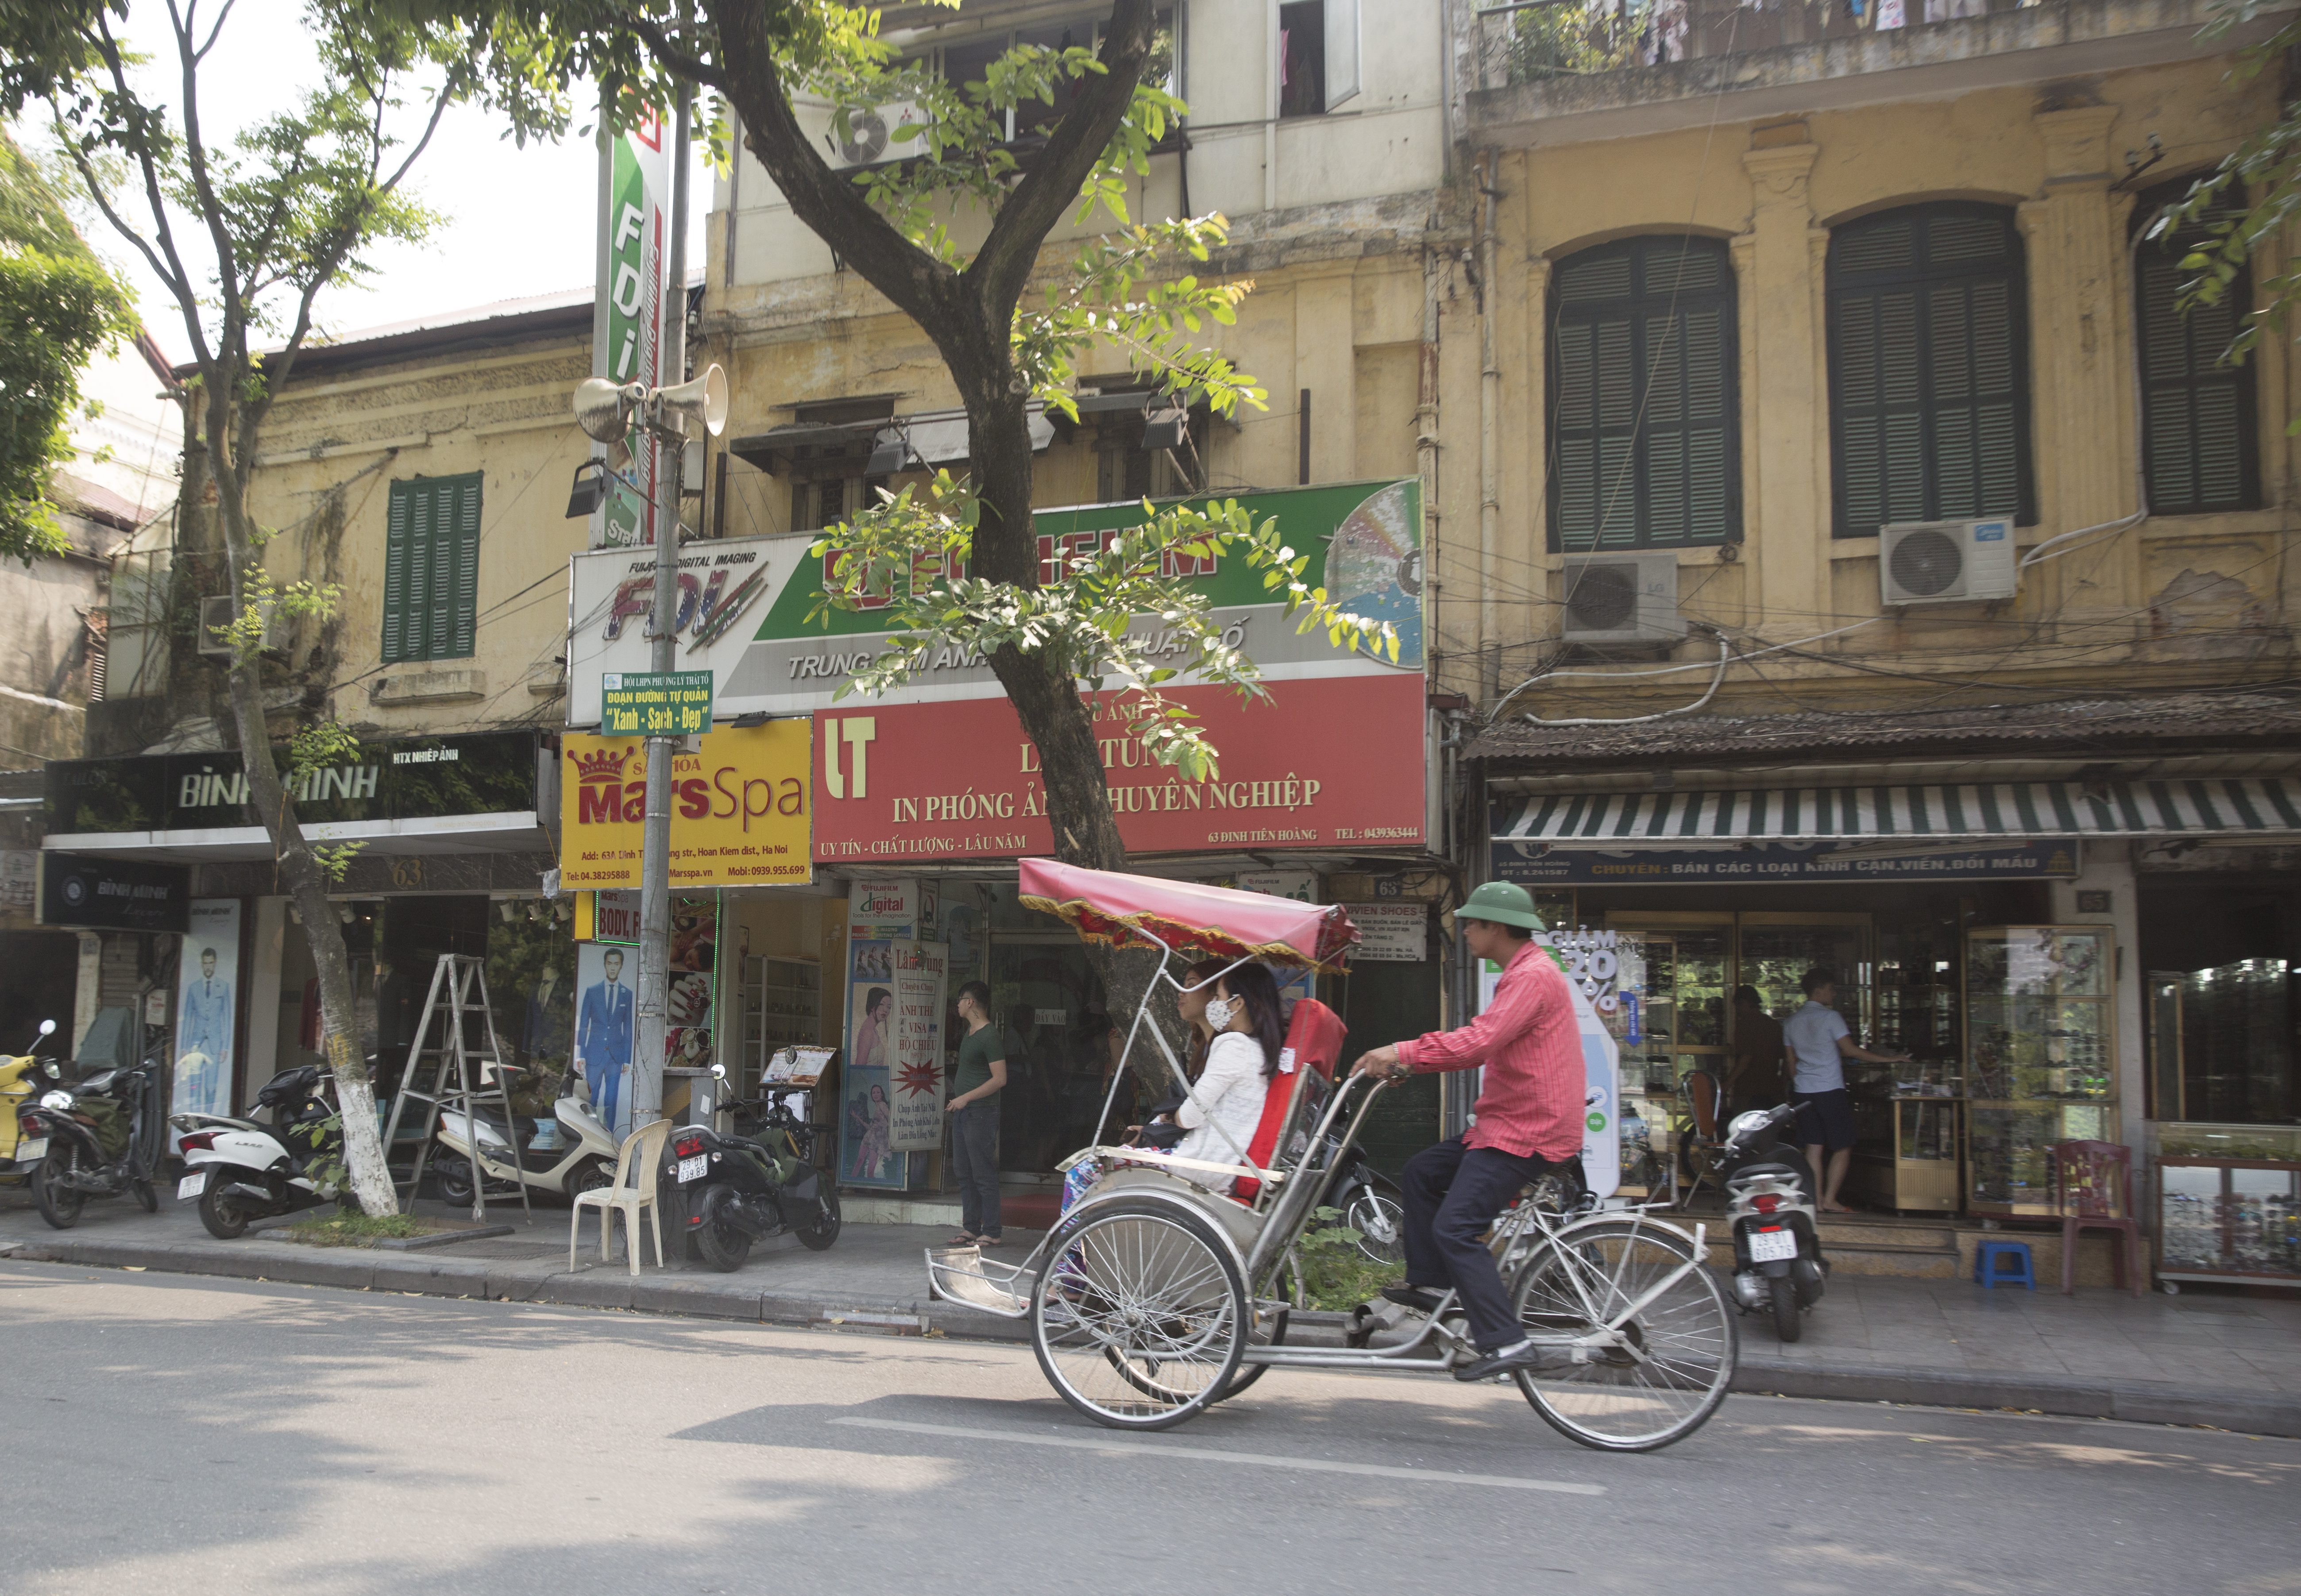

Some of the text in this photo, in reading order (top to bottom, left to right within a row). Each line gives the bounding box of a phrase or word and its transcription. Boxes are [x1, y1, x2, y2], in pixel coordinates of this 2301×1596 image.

[677, 556, 710, 568] DIGITAL
[715, 552, 757, 565] IMAGING
[789, 652, 870, 678] TRUNG
[624, 676, 635, 688] HỘI
[636, 678, 651, 686] LHPN
[677, 675, 684, 685] LÝ
[686, 674, 699, 685] THÁI
[607, 686, 708, 705] ĐOẠN ĐƯỜNG TỰ QUẢN
[648, 707, 672, 734] Sạch
[394, 752, 411, 764] HTX
[439, 745, 458, 761] ẢNH
[892, 798, 919, 822] IN
[925, 786, 1015, 820] PHÓNG
[1107, 777, 1202, 812] HUYÊN
[1209, 772, 1320, 812] NGHIỆP
[1208, 826, 1418, 843] 63 ĐINH TIÊN HOÀNG TEL 0439363444
[582, 851, 598, 860] Add:
[602, 851, 616, 860] 63A
[619, 850, 635, 859] Dinh
[698, 848, 717, 856] Hoan
[720, 846, 739, 856] Kiem
[762, 845, 772, 855] Ha
[775, 845, 788, 854] Noi
[821, 833, 1027, 856] UY TÍN CHẤT LƯỢNG LÂU NĂM
[393, 860, 421, 886] 63
[566, 872, 579, 880] Tel:
[581, 870, 630, 880] 04.38295888
[728, 867, 750, 876] Mobi:
[752, 865, 805, 875] 0939.955.699
[1591, 862, 1661, 874] CHUYÊN
[1672, 861, 1709, 873] BÁN
[1715, 861, 1752, 873] CÁC
[1757, 863, 1798, 876] LOẠI
[860, 892, 903, 914] digital
[1380, 907, 1417, 916] SHOES
[599, 908, 629, 940] BODY,
[1546, 924, 1615, 948] GIẢM
[922, 951, 943, 977] ùng
[1561, 950, 1617, 979] 20
[902, 982, 934, 993] Chuyên Chụp
[900, 1001, 934, 1016] ẢNH THẺ
[909, 1022, 927, 1033] VISA
[899, 1036, 911, 1052] HỘ
[893, 1118, 898, 1127] In
[898, 1131, 908, 1140] Làm
[680, 1166, 705, 1181] 939.85
